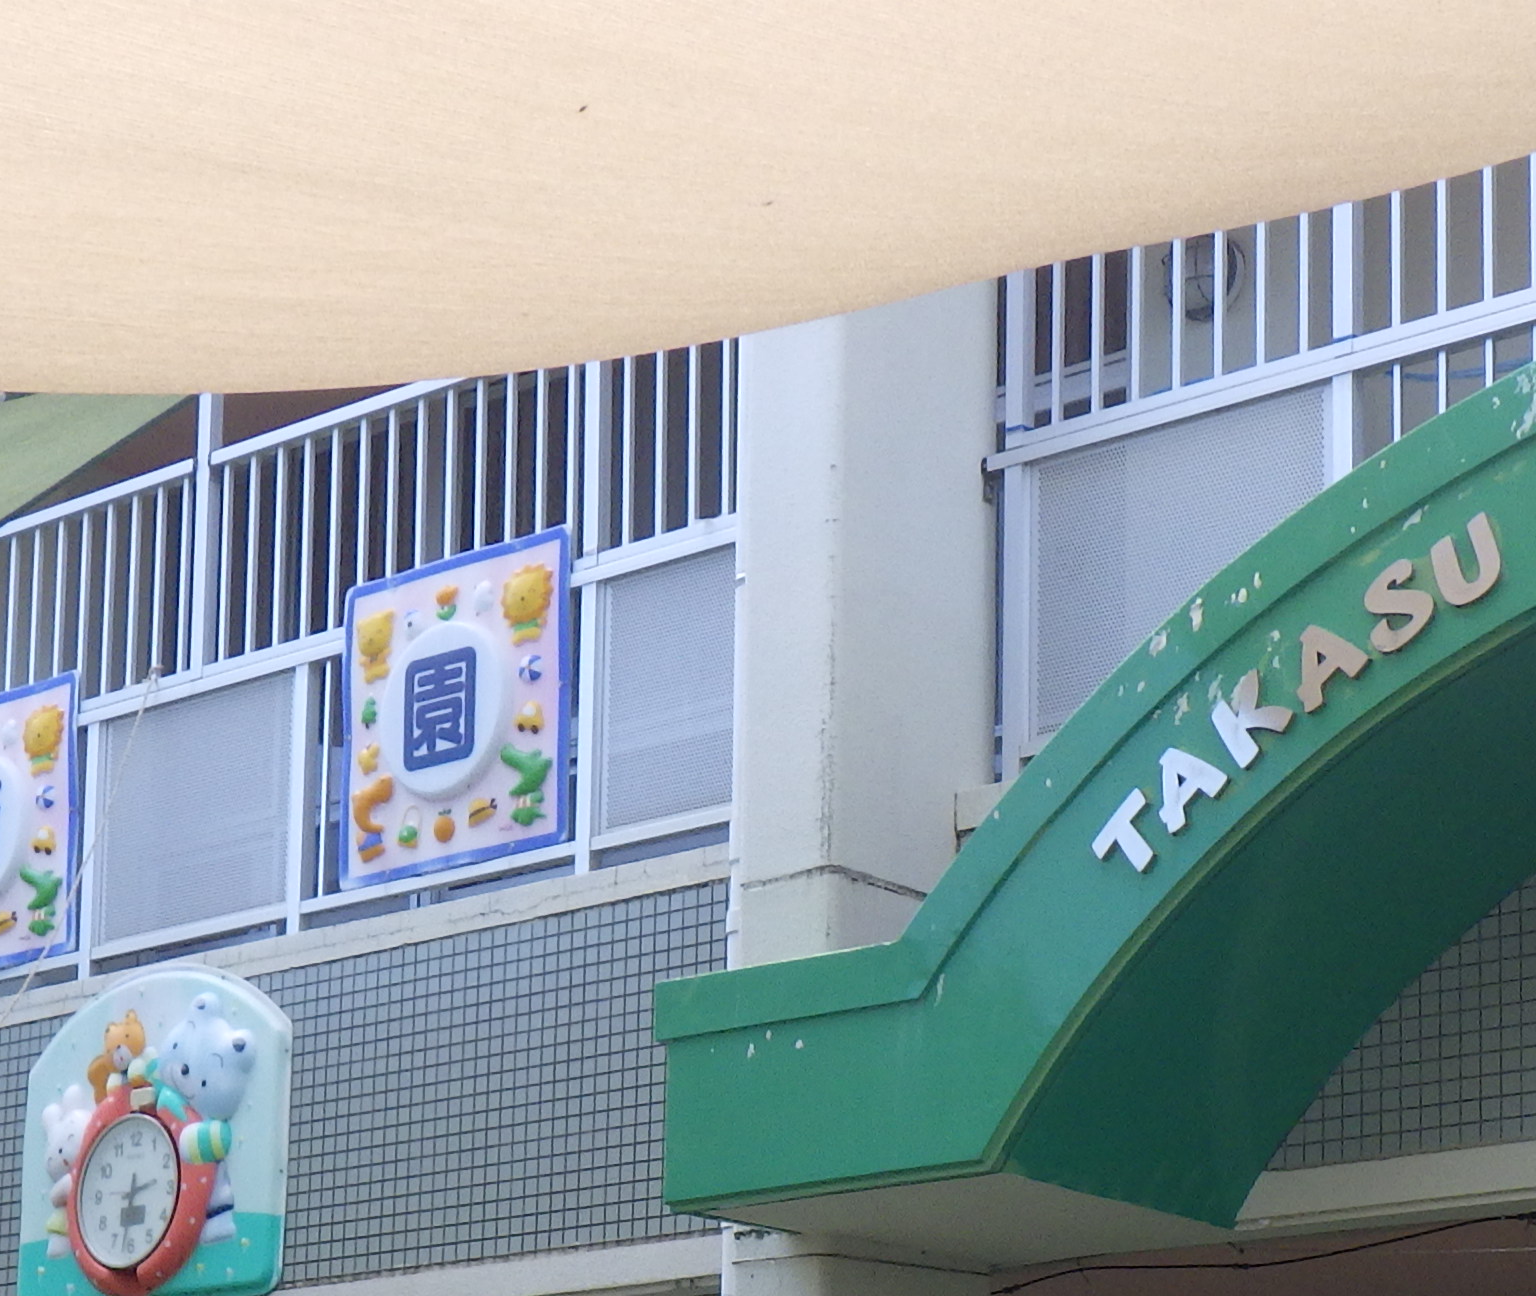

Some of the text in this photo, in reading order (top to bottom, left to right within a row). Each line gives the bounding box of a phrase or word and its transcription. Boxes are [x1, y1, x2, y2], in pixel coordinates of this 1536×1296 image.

[1092, 513, 1502, 873] TAKASU
[404, 646, 477, 772] 園
[130, 1131, 143, 1147] 12
[151, 1136, 157, 1151] 1
[114, 1142, 124, 1158] 11
[162, 1153, 171, 1169] 2
[100, 1163, 113, 1179] 10
[166, 1180, 174, 1195] 3
[95, 1190, 103, 1205] 9
[99, 1216, 107, 1231] 8
[145, 1229, 154, 1243] 5
